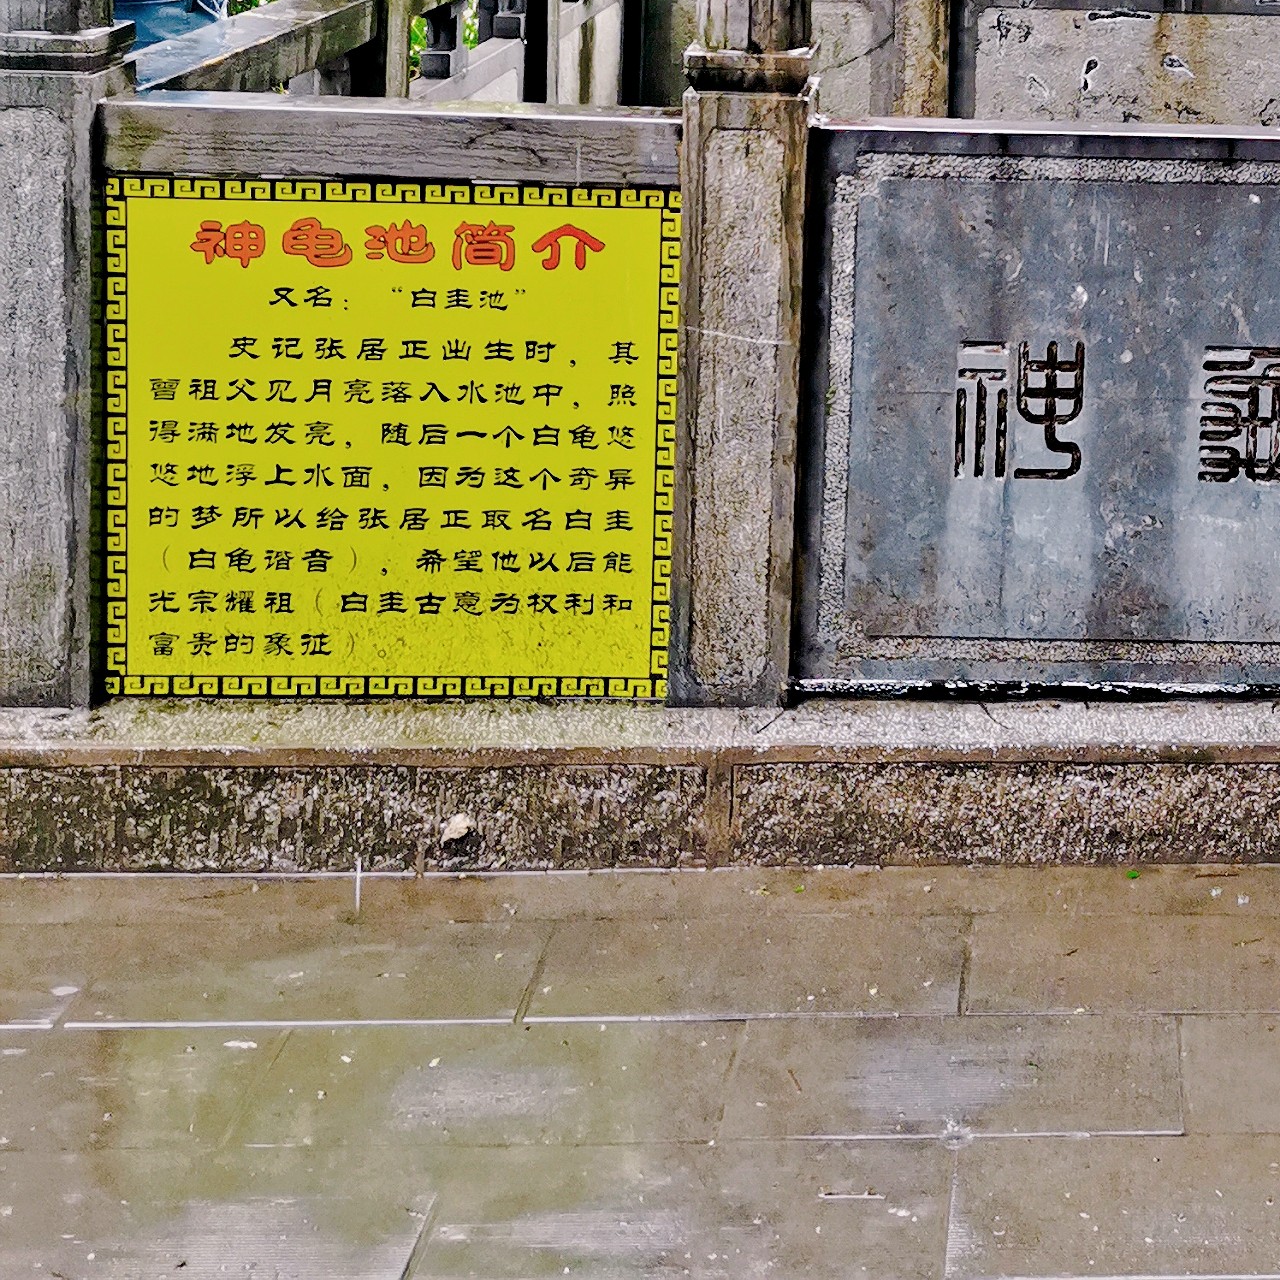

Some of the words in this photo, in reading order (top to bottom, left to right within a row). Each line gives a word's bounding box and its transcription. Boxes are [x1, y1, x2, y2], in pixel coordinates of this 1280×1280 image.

[190, 217, 606, 272] 神龟池简介
[229, 337, 639, 367] 史记张居正出生时，其
[149, 420, 635, 450] 得满地发亮，随后一个白龟悠
[149, 462, 635, 492] 悠地浮上水面，因为这个奇异
[148, 504, 634, 532] 的梦所以给张居正取名白圭
